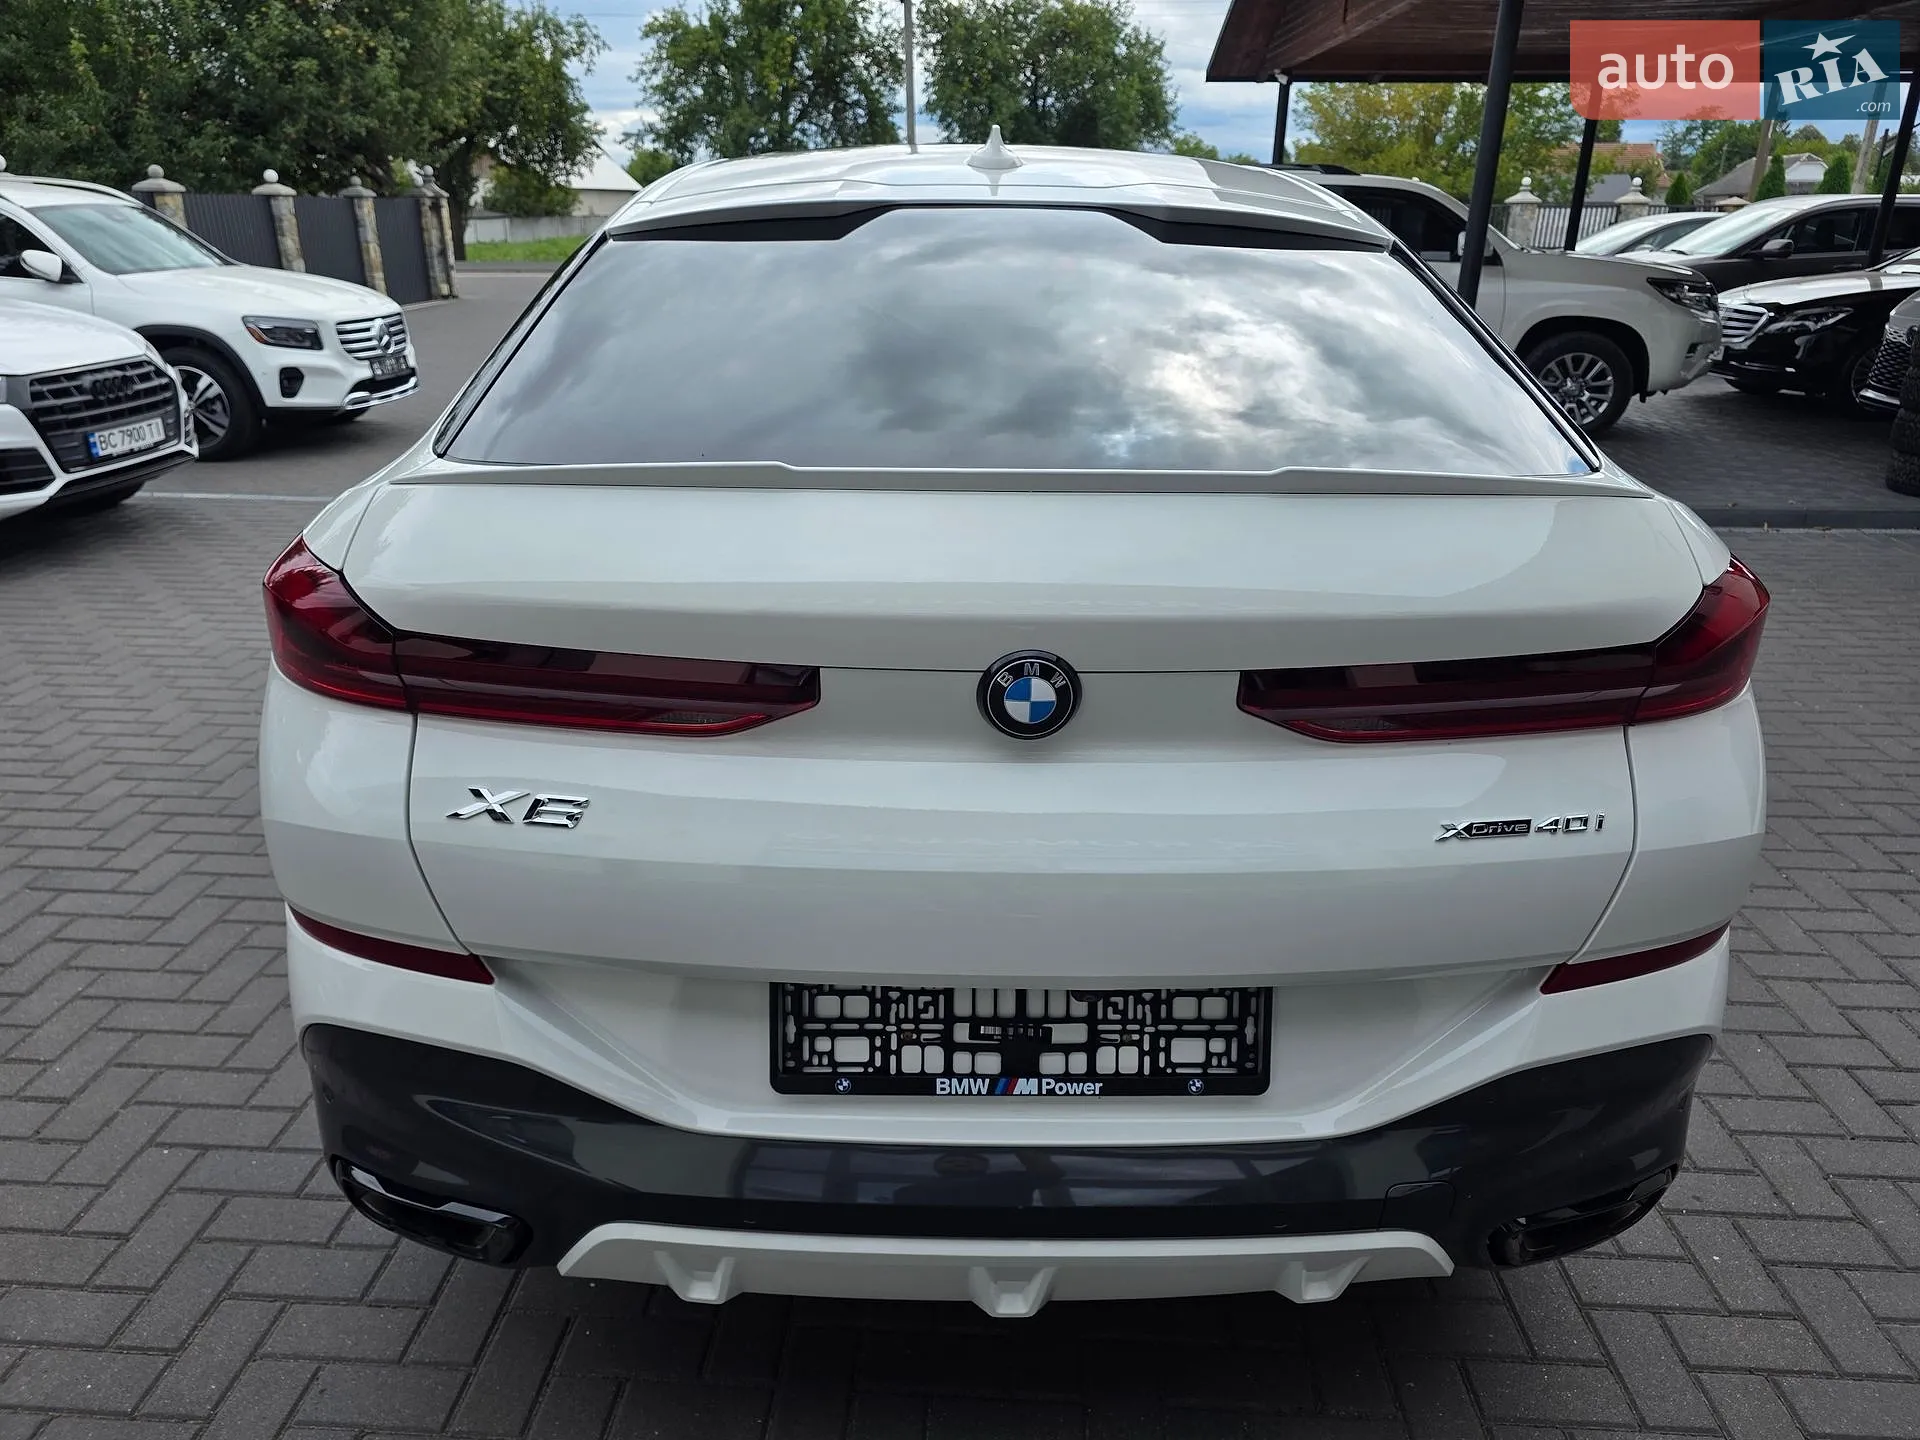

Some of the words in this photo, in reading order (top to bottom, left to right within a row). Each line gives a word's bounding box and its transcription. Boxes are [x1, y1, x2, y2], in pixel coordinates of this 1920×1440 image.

[99, 432, 117, 451] BC
[118, 425, 146, 446] 7900
[997, 662, 1066, 689] BMW
[445, 786, 591, 829] X6
[936, 1078, 990, 1095] BMW
[1041, 1078, 1103, 1095] Power
